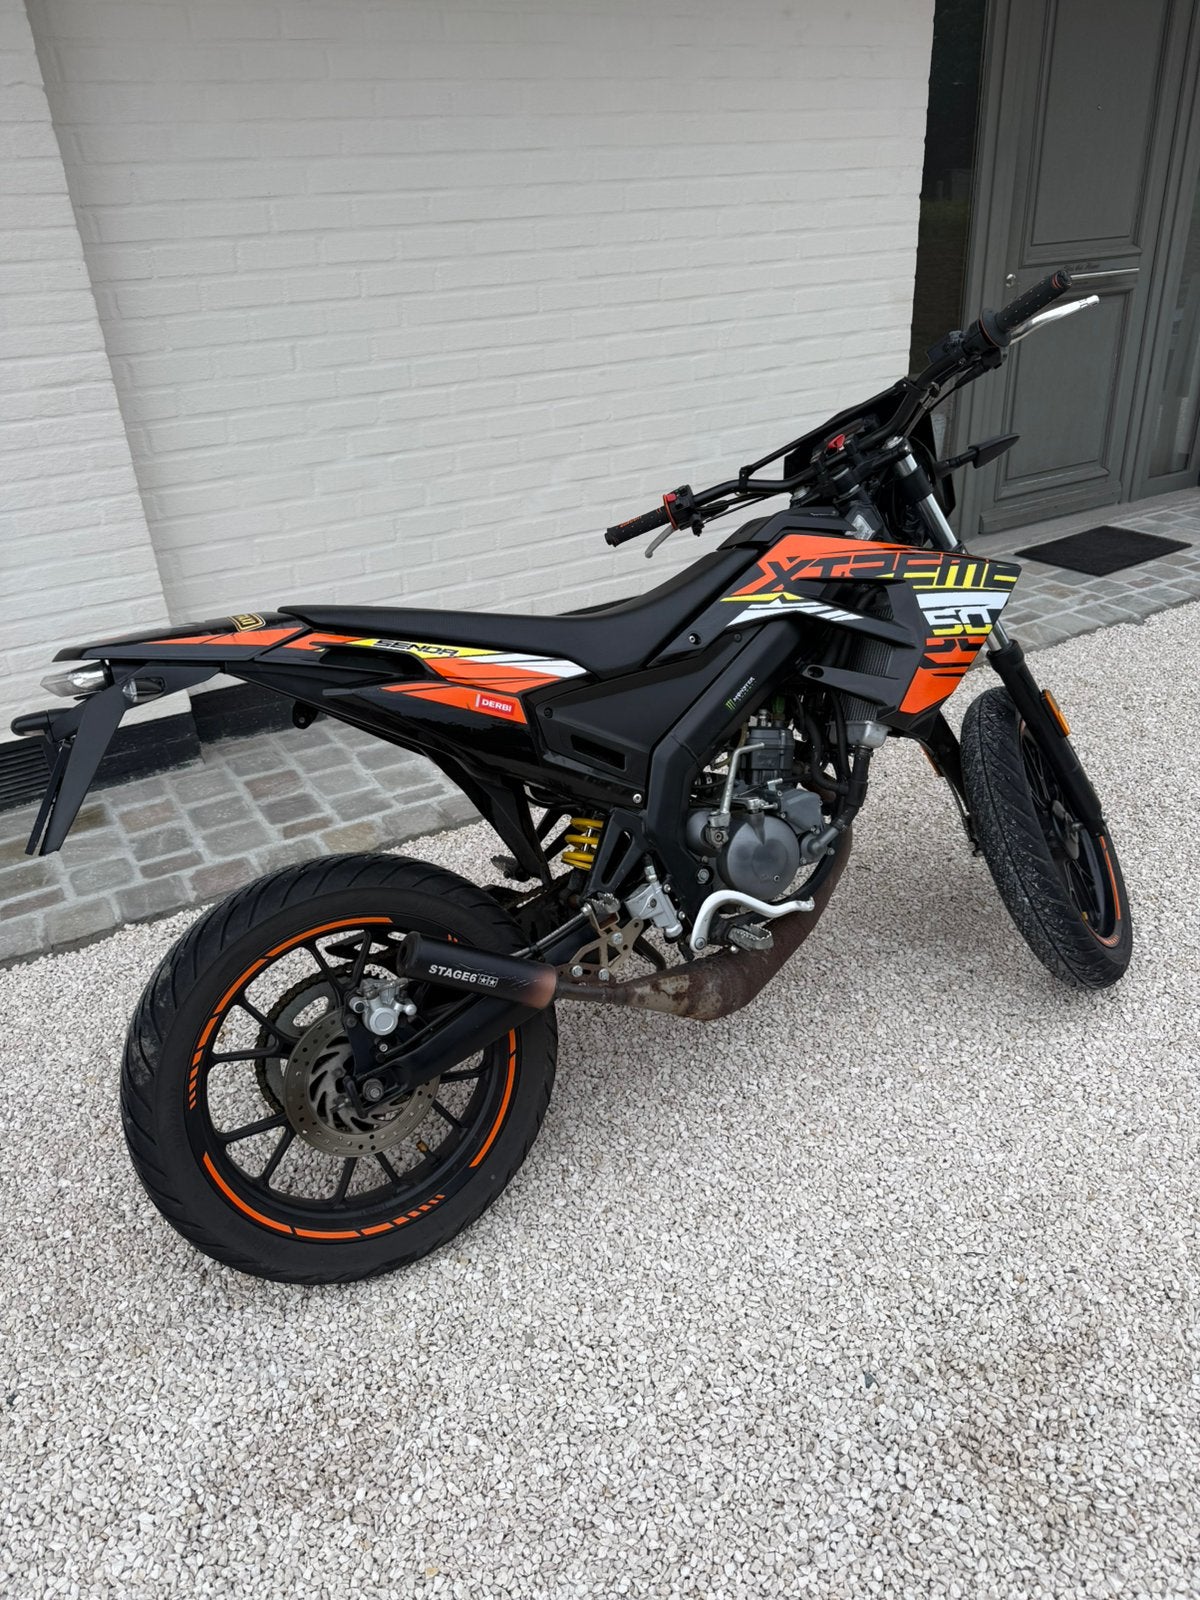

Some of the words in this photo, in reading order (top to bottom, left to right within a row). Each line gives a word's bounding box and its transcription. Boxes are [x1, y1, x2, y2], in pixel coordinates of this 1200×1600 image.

[922, 606, 993, 637] 50
[481, 698, 513, 713] DERBI
[429, 965, 478, 983] STAGE6
